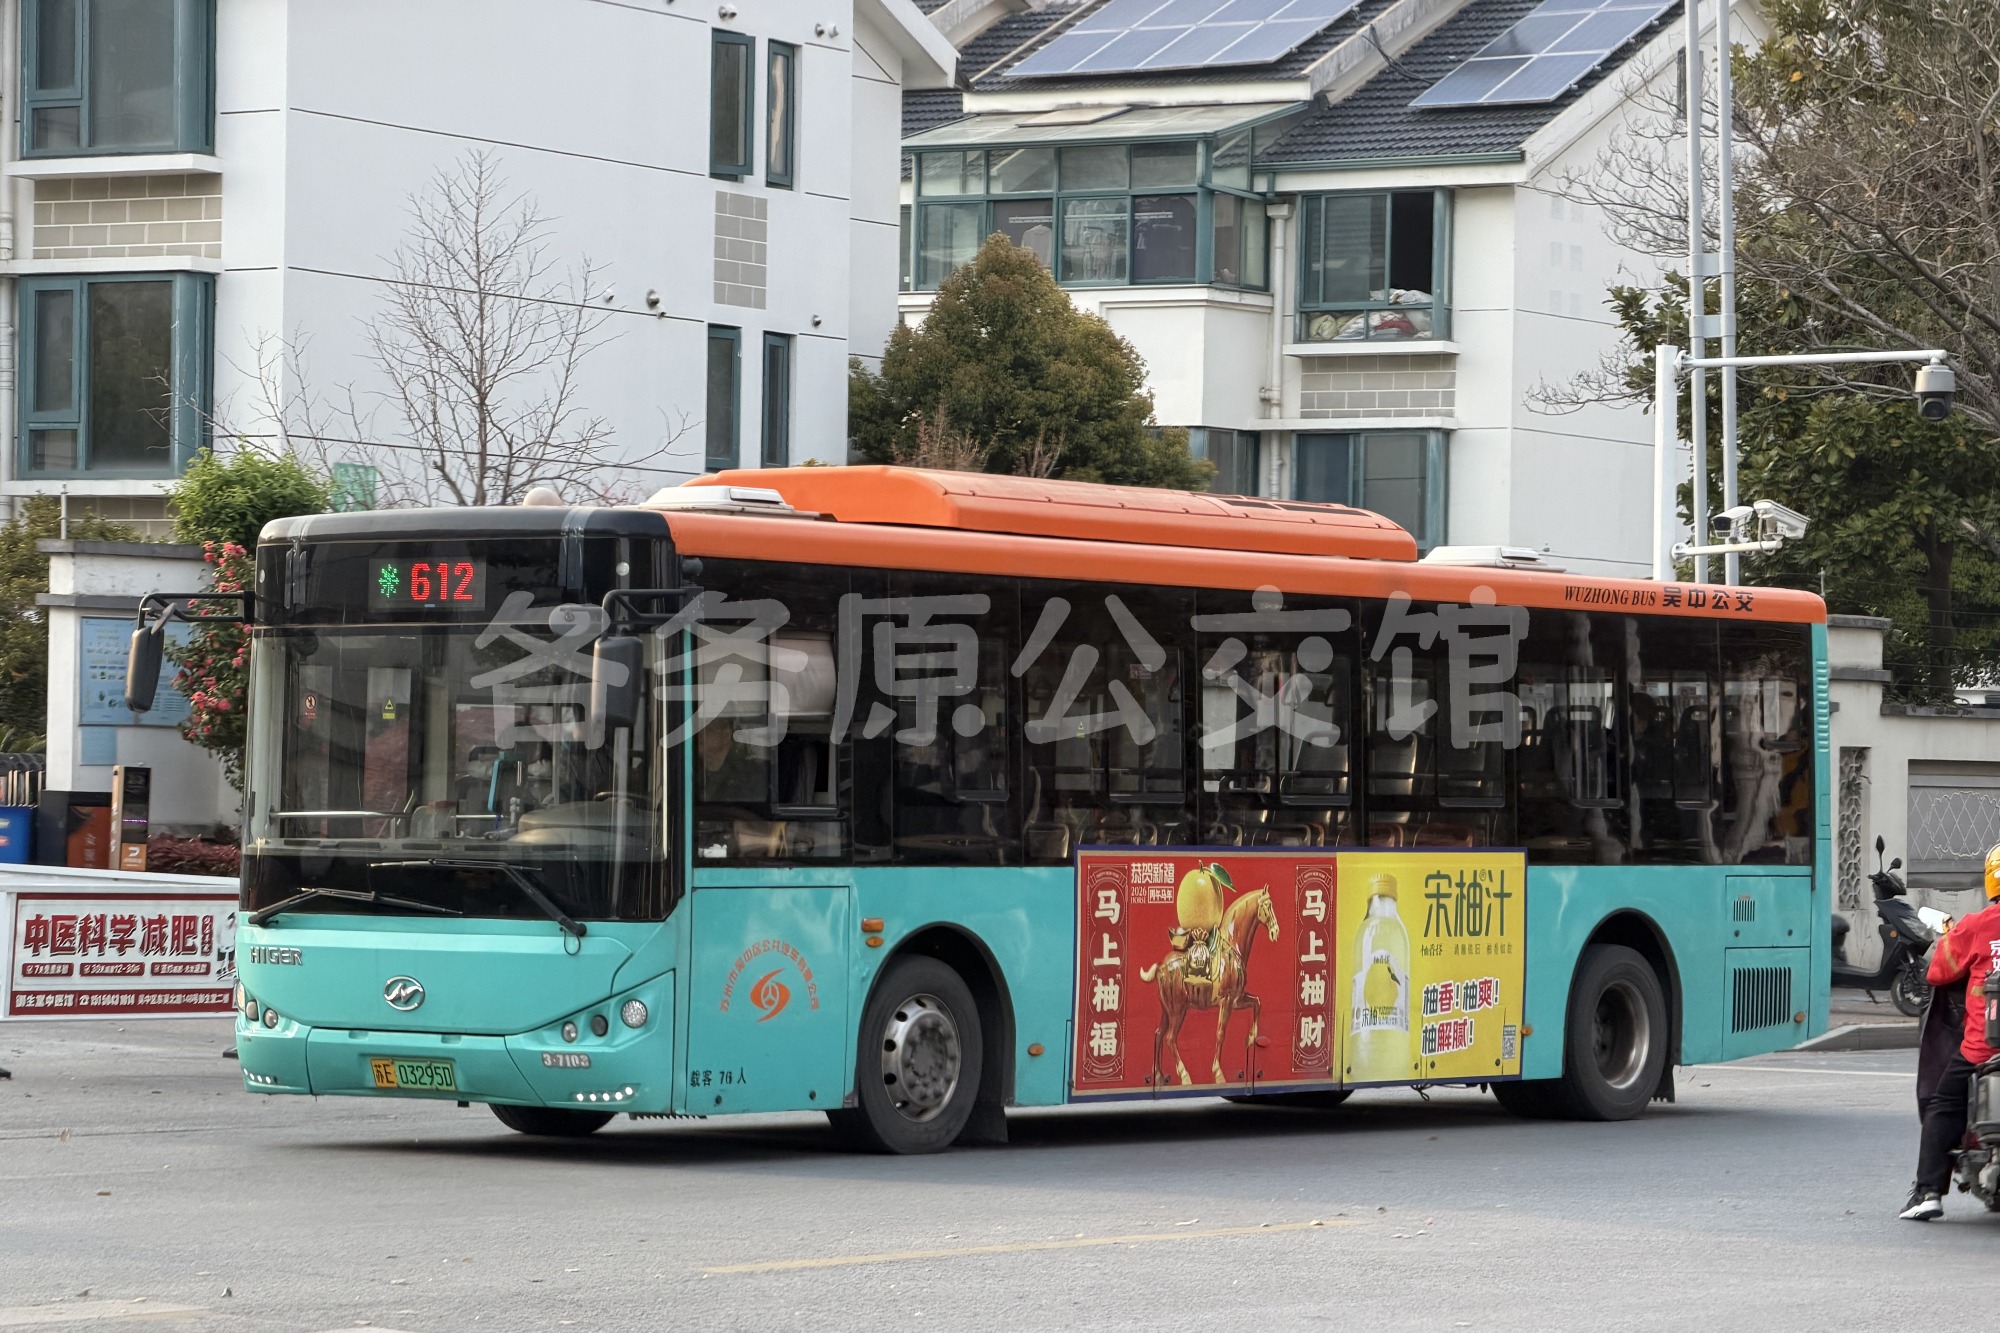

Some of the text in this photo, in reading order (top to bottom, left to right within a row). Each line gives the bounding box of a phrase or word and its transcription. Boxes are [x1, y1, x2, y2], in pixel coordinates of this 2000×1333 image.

[411, 562, 474, 600] 612
[1564, 585, 1754, 612] WUZHONG BUS 吴中公交
[1130, 863, 1175, 883] 恭贺新禧
[1131, 886, 1147, 896] 2026
[1423, 869, 1513, 937] 宋柚汁
[23, 913, 199, 957] 中医科学减肥
[250, 946, 303, 966] HIGER
[373, 1063, 454, 1087] 苏E 03295D
[719, 1070, 732, 1085] 76
[736, 1066, 747, 1085] 人
